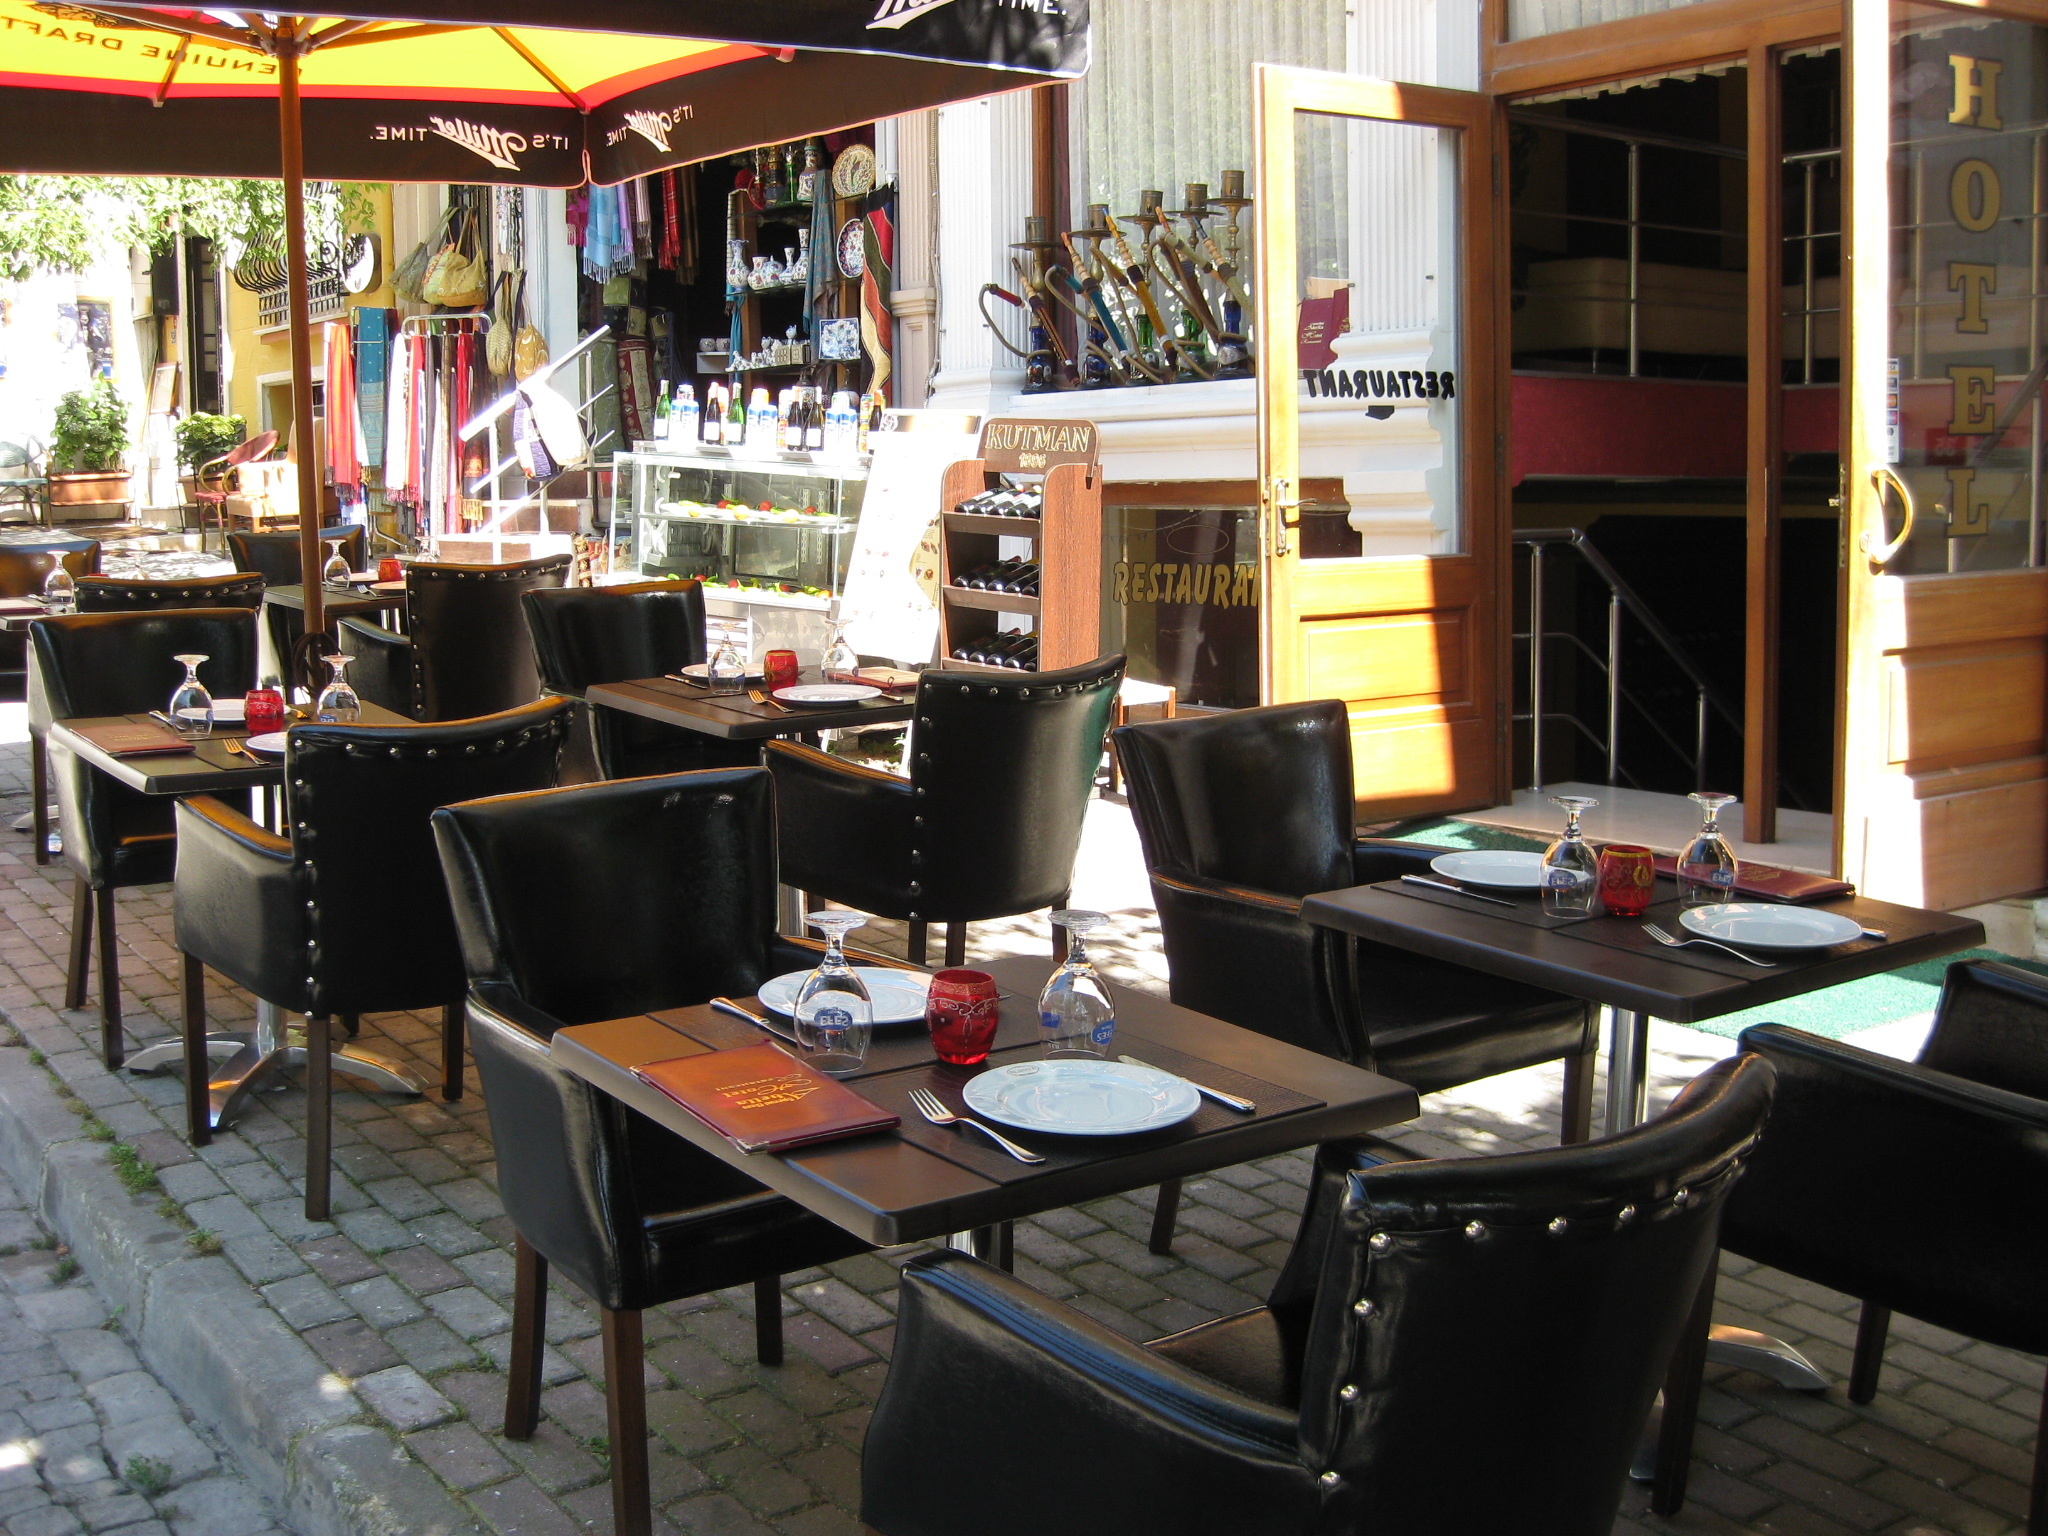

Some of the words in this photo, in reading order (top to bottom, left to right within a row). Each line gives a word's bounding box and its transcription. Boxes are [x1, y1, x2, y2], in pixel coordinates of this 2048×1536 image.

[1946, 52, 2004, 538] HOTEL
[984, 424, 1092, 453] KUTMAN
[723, 1079, 812, 1098] Hotel
